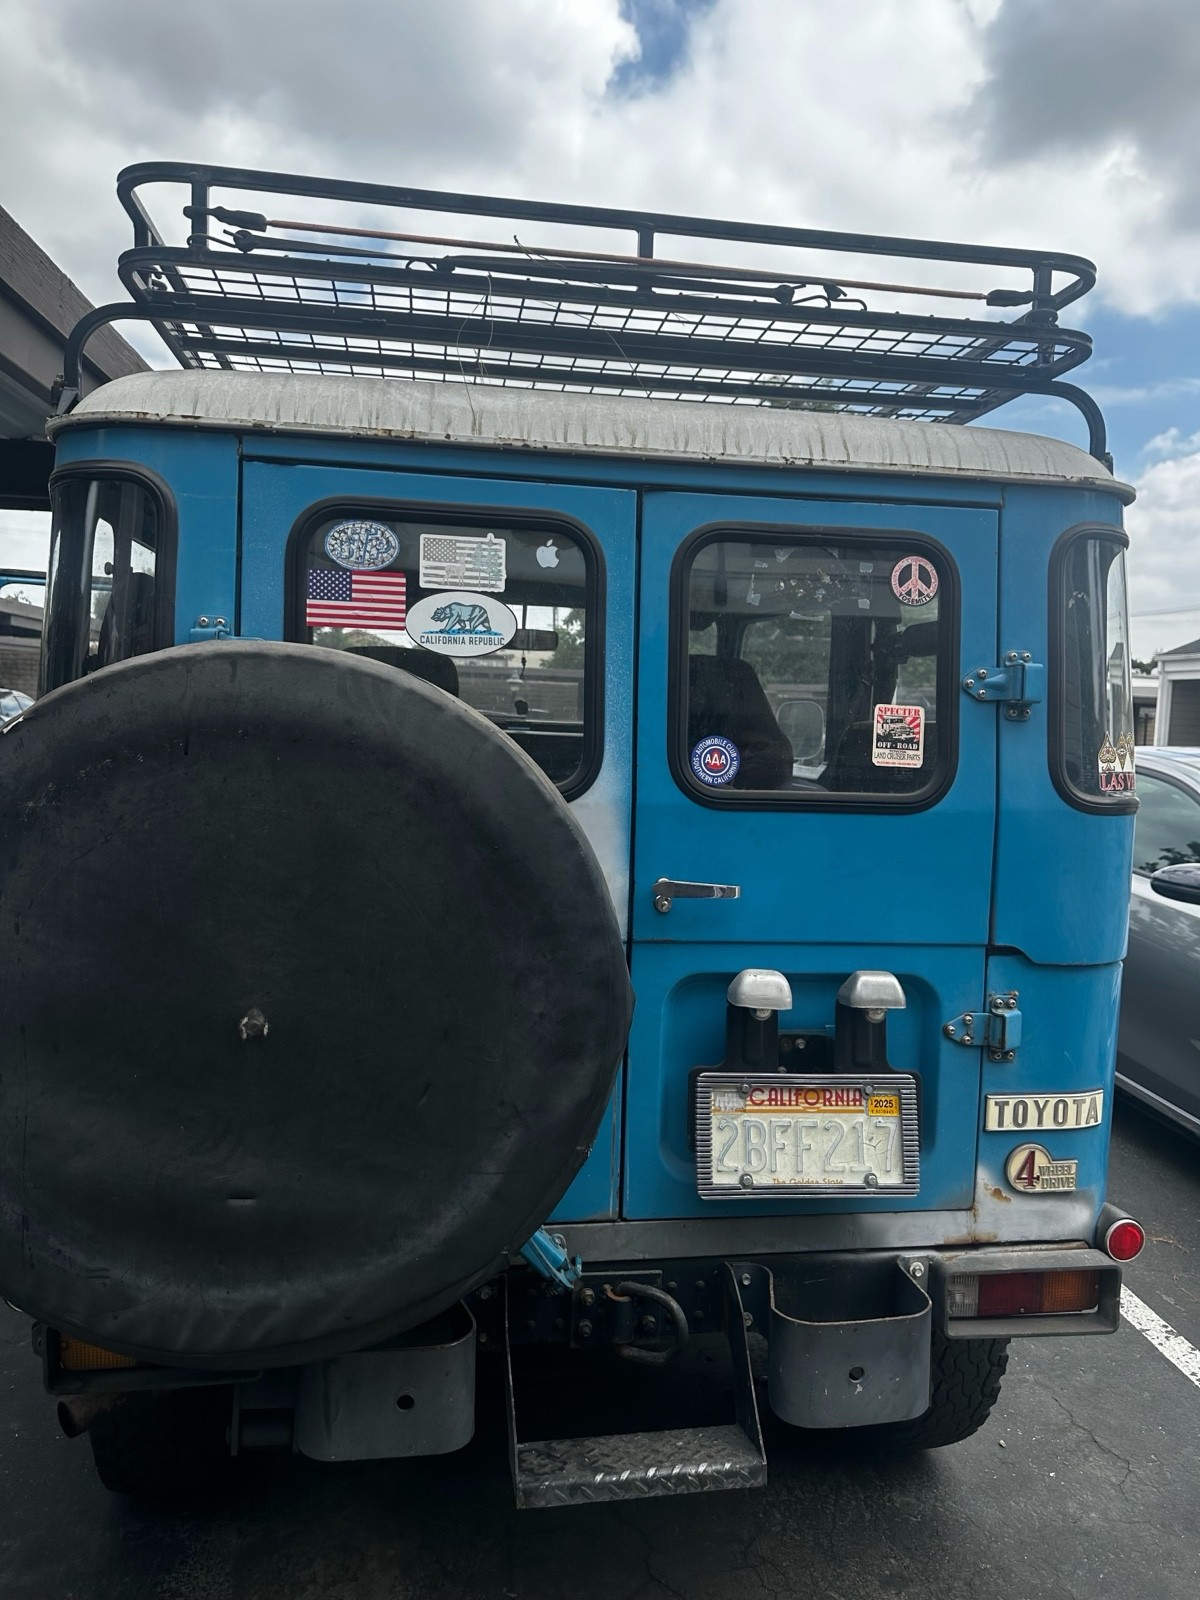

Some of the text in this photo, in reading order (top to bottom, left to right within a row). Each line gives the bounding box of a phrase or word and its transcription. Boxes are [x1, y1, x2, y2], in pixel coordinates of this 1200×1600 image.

[899, 591, 932, 605] YOSEMITE
[420, 635, 505, 646] CALIFORNIA REPUBLIC
[877, 706, 921, 717] SPECTER
[695, 737, 738, 758] AUTOMOBILE CLUB
[705, 753, 726, 766] AAA
[874, 751, 886, 760] LAND
[906, 753, 921, 762] PARTS
[693, 757, 738, 784] SOUTHERN CALIFORNIA
[1101, 773, 1124, 791] LAS
[749, 1087, 864, 1106] CALIFORNIA
[873, 1099, 894, 1108] 2025
[994, 1096, 1099, 1129] TOYOTA
[717, 1118, 898, 1173] 2BFF217
[1014, 1149, 1040, 1189] 4
[1039, 1164, 1075, 1177] WHEEL
[1040, 1176, 1075, 1190] DRIVE
